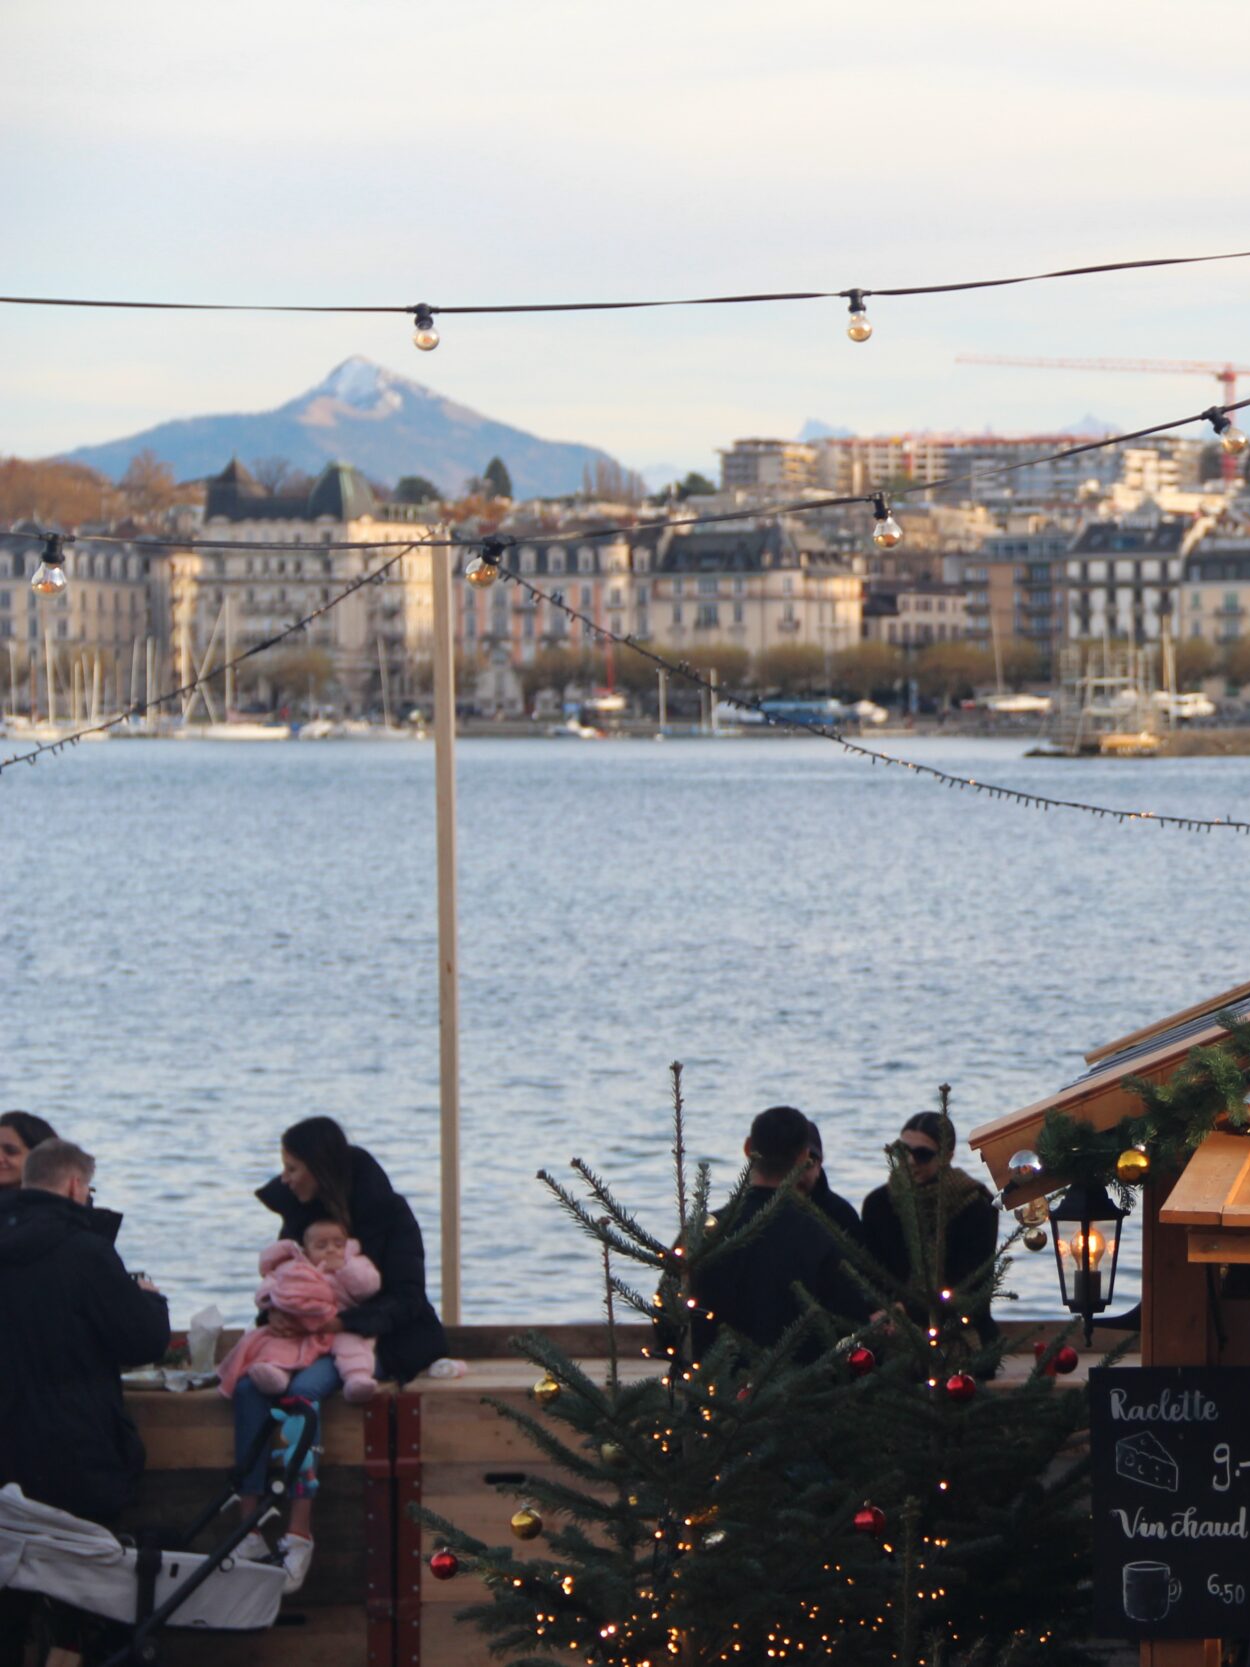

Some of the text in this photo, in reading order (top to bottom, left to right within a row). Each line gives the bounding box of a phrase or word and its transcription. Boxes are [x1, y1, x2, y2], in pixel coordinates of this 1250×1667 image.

[1110, 1388, 1218, 1421] Raclette
[1110, 1507, 1248, 1539] Vin chaud
[1207, 1574, 1245, 1604] 6.50
